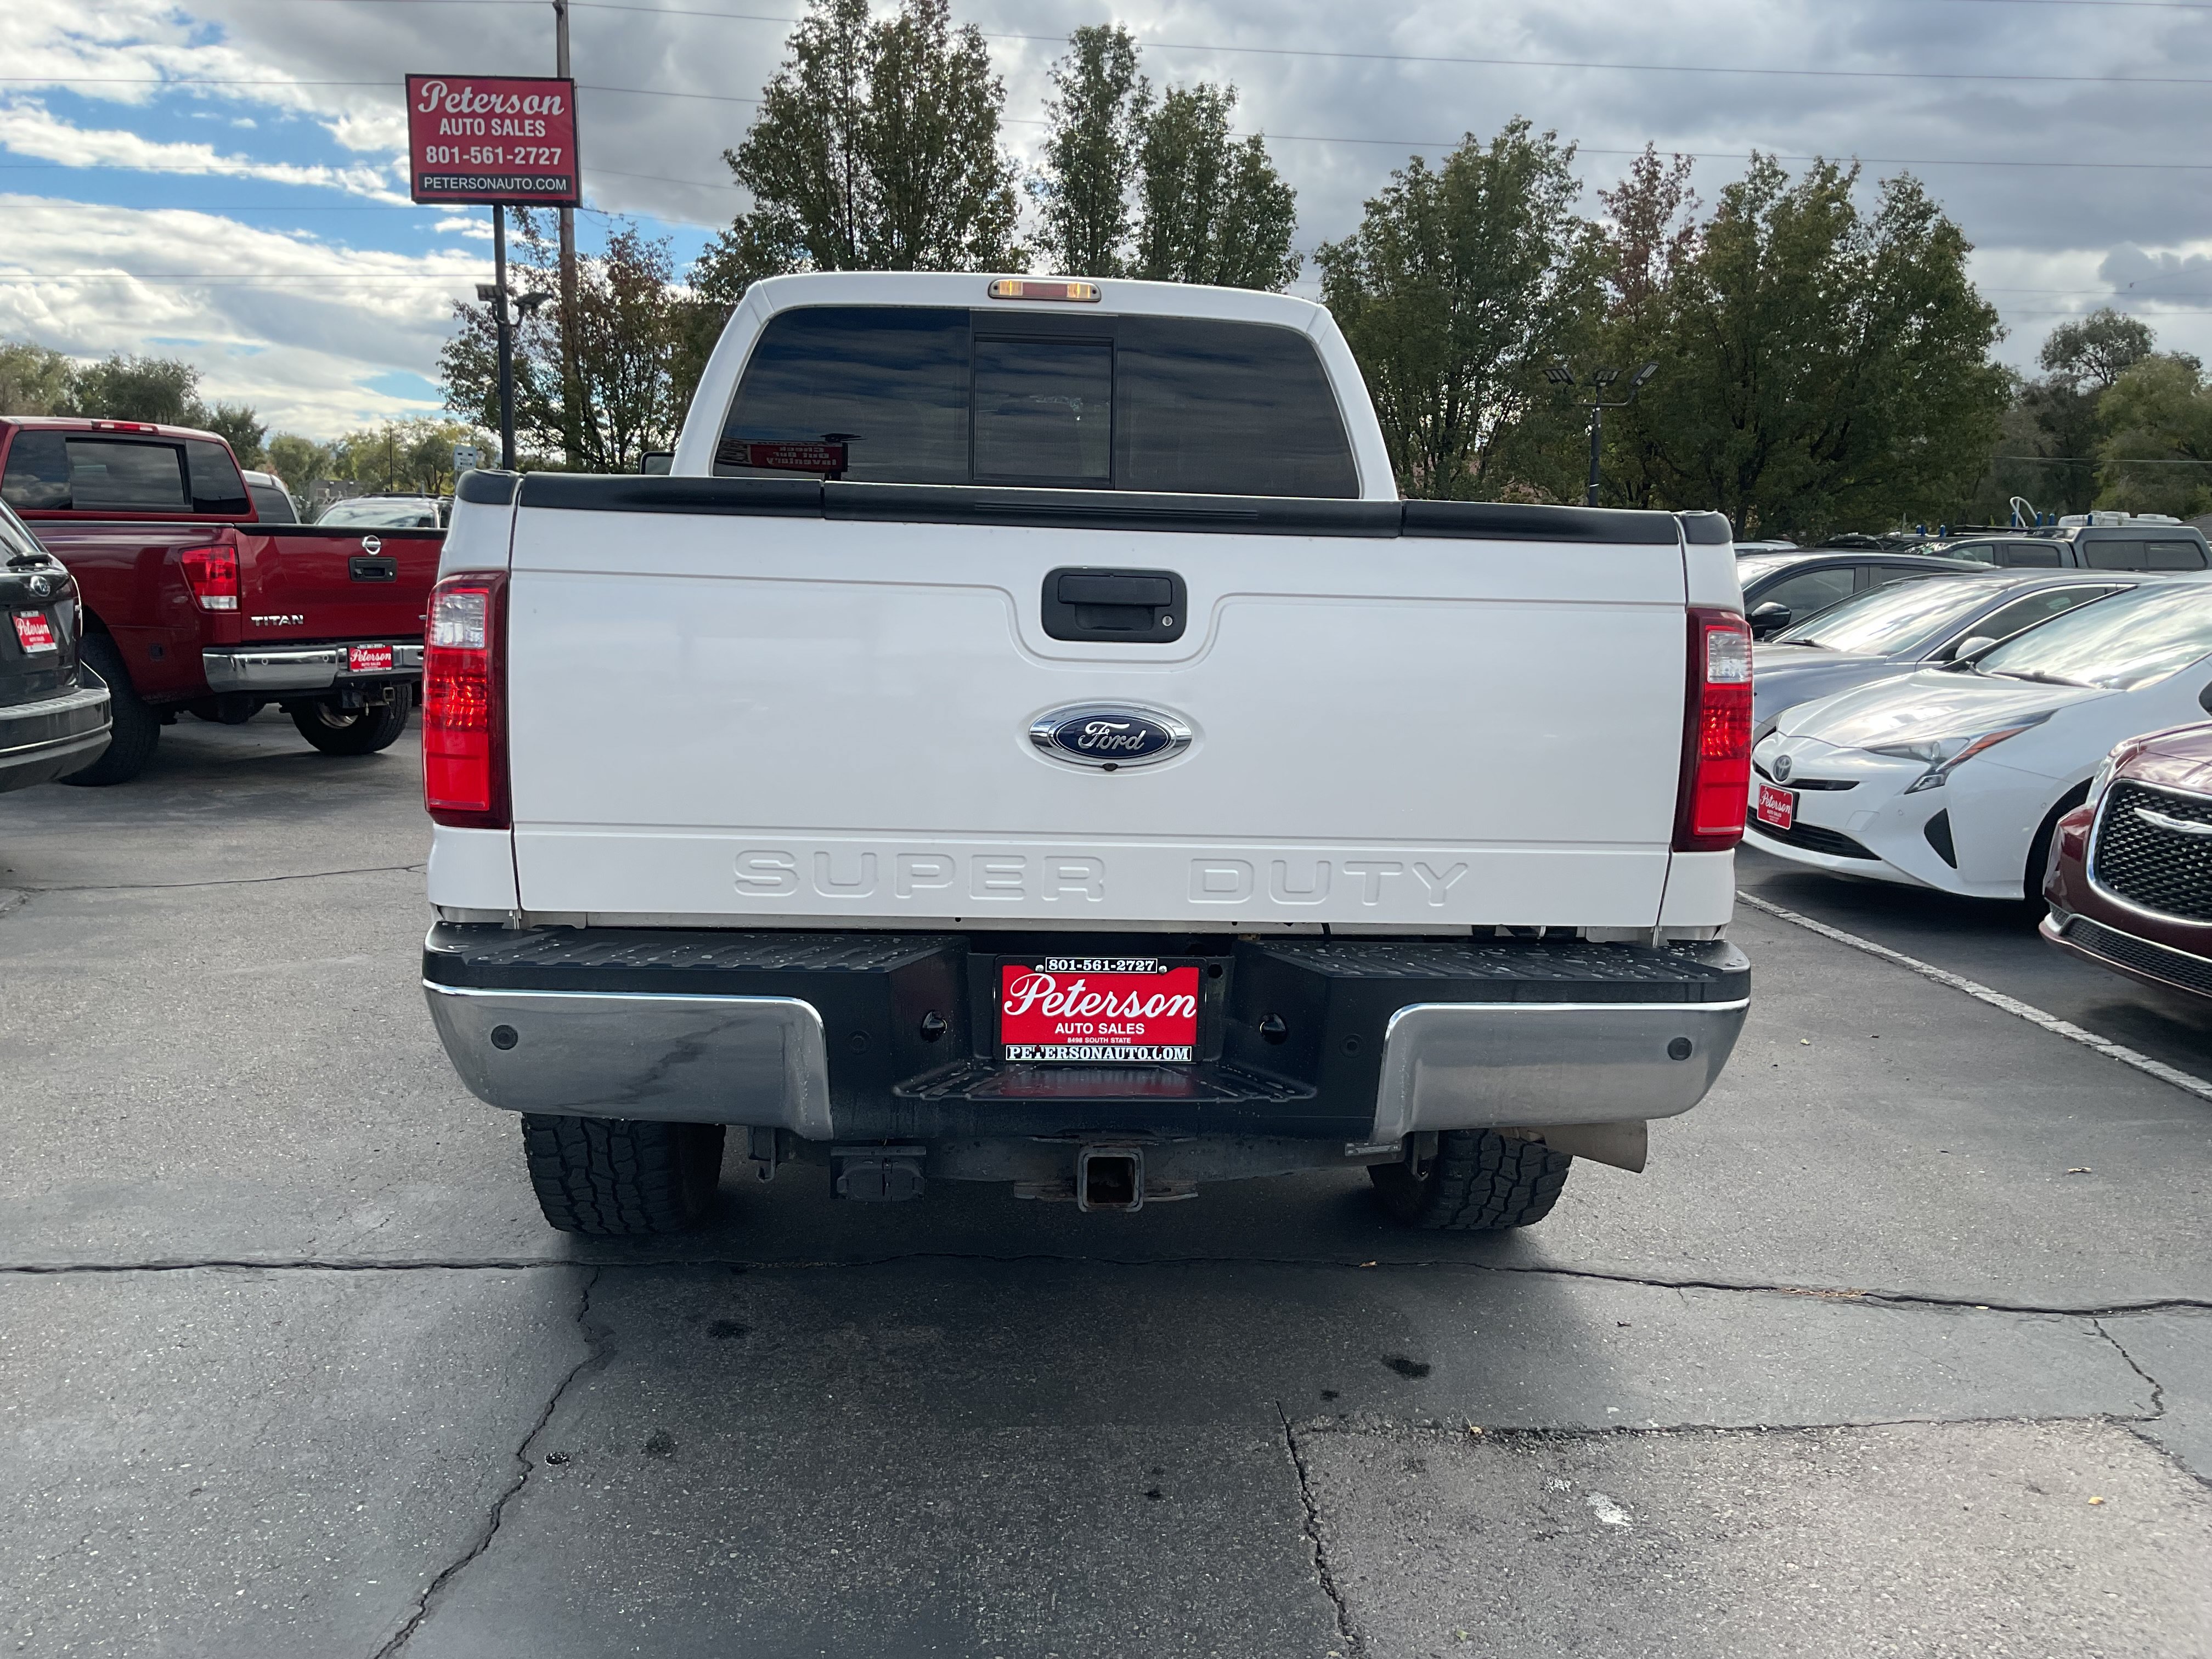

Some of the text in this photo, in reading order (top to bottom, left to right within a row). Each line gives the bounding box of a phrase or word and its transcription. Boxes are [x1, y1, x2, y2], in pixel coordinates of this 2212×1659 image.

[418, 80, 565, 116] Peterson
[439, 118, 545, 137] AUTO SALES
[426, 145, 562, 165] 801-561-2727
[424, 177, 566, 191] PETERSONAUTO.COM
[15, 618, 50, 636] Peterson
[251, 614, 303, 626] TITAN
[350, 650, 391, 662] Peterson
[1077, 721, 1147, 750] Ford
[1759, 790, 1791, 814] Peterson
[733, 849, 1468, 907] SUPER DUTY
[1048, 959, 1154, 972] 801-561-2727
[1003, 973, 1197, 1018] Peterson
[1054, 1023, 1145, 1035] AUTO SALES
